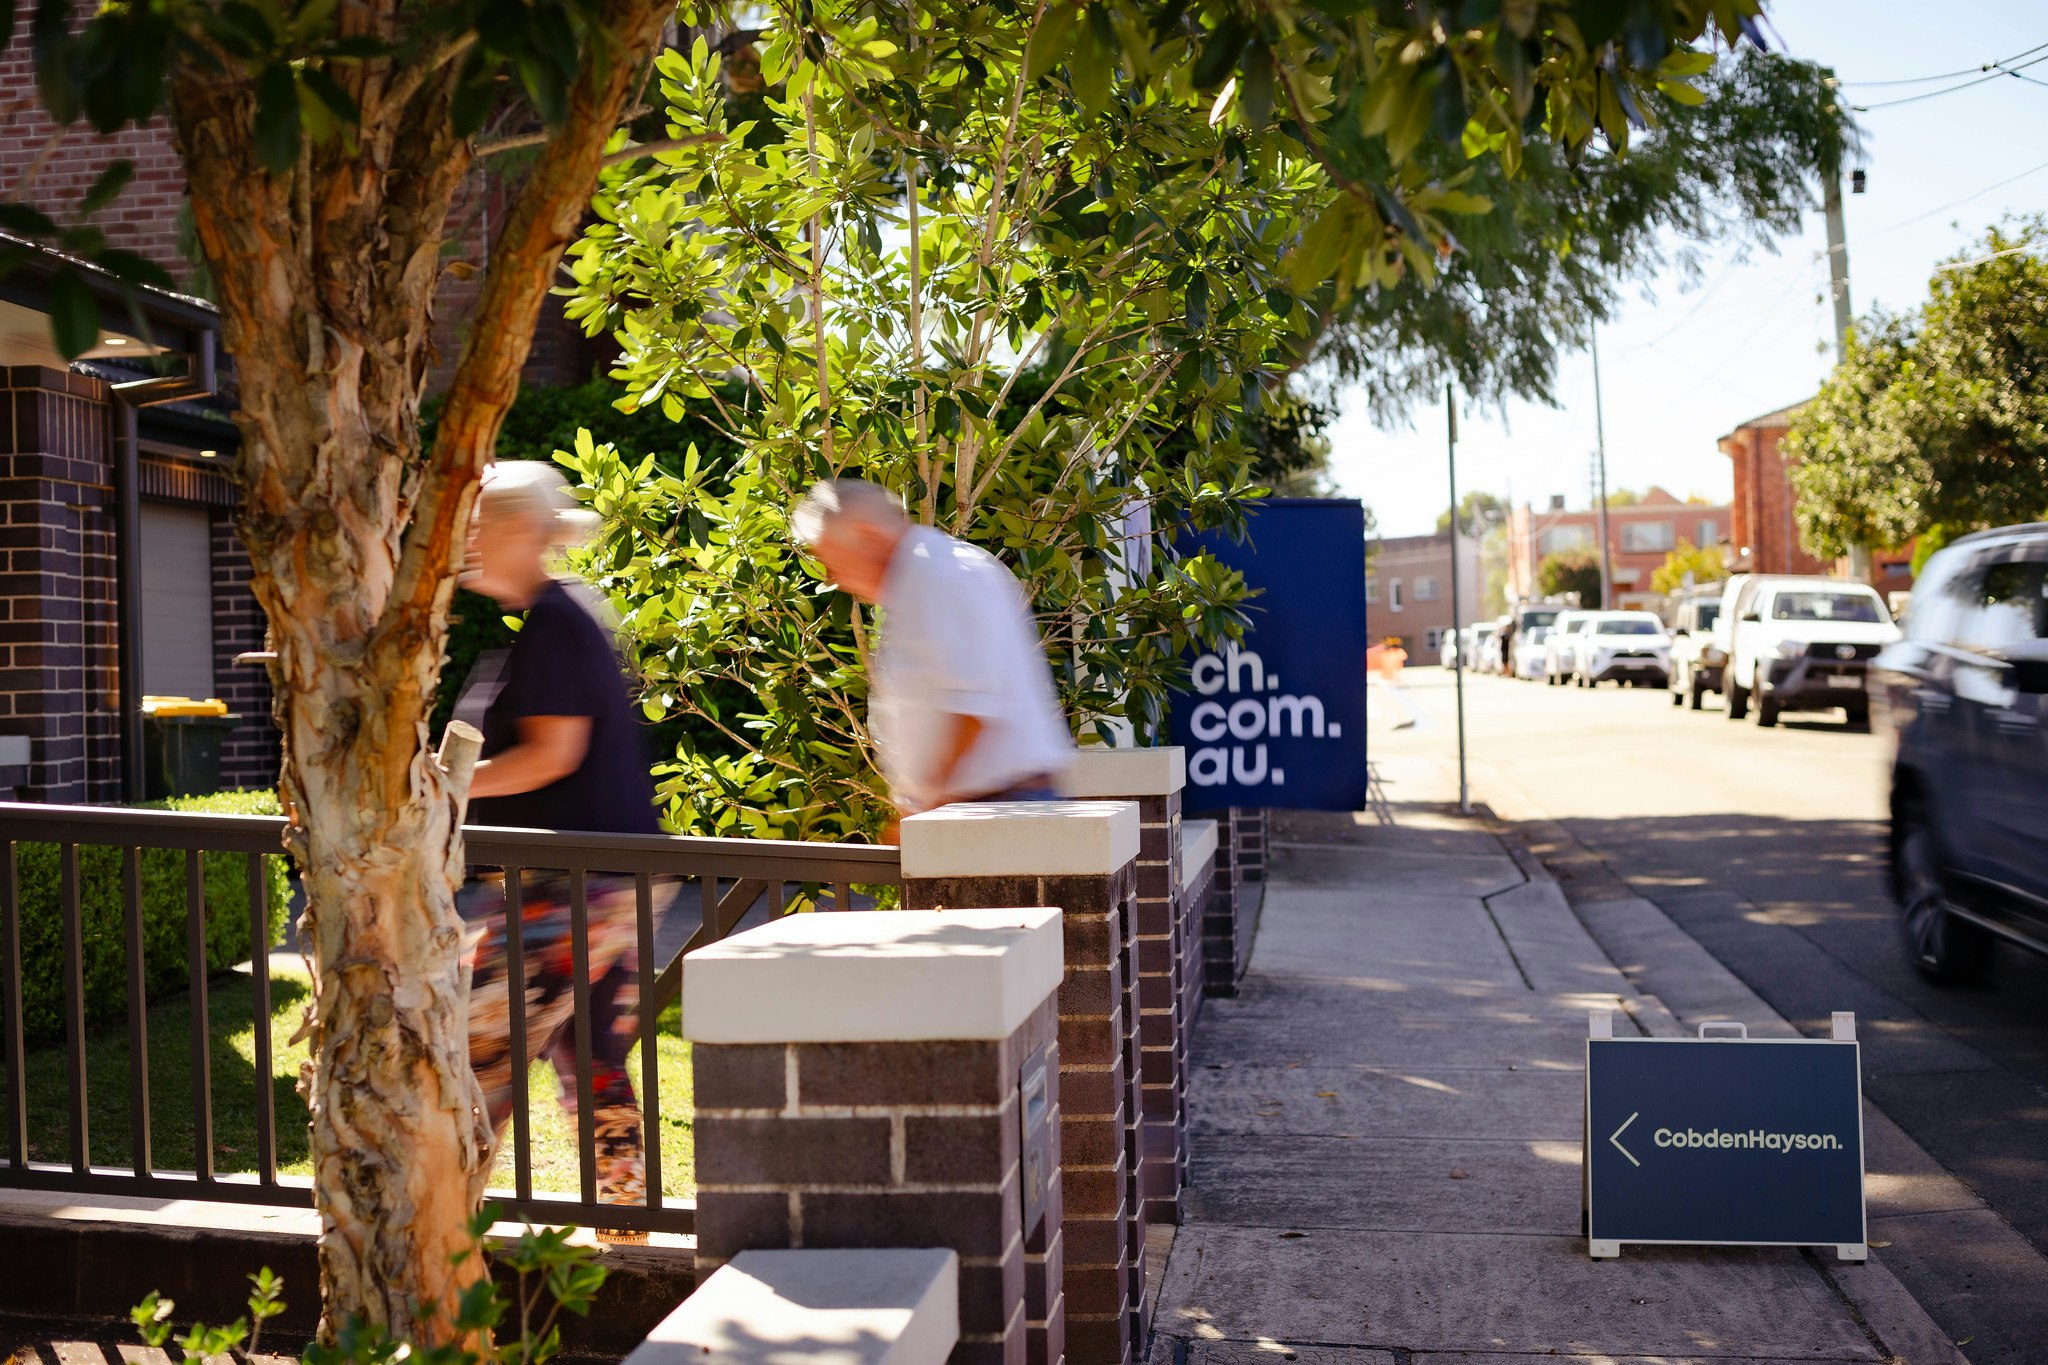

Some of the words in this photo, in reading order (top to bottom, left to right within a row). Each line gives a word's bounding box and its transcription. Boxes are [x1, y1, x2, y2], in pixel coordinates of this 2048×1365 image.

[1191, 640, 1279, 695] ch.
[1190, 694, 1342, 742] com.
[1188, 743, 1285, 786] au.
[1654, 1128, 1843, 1153] CobdenHayson.
